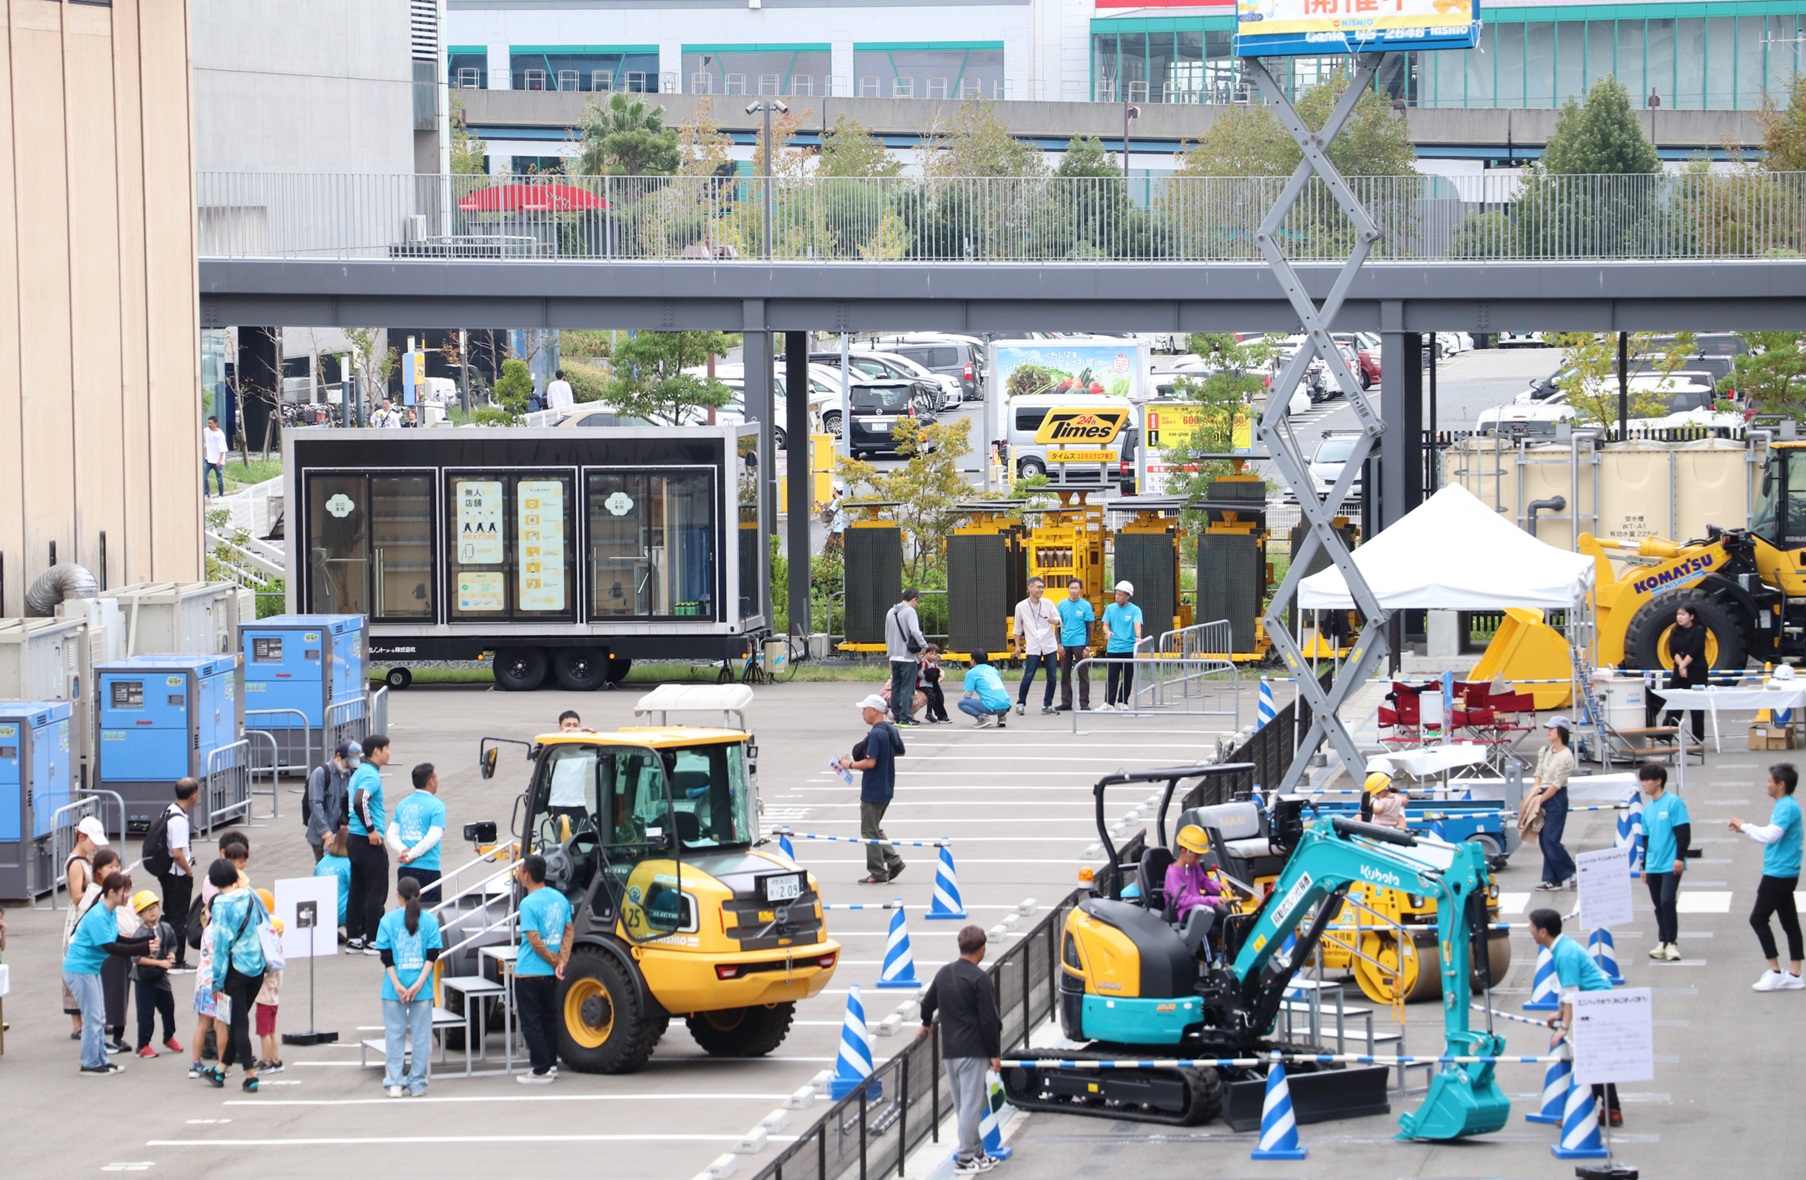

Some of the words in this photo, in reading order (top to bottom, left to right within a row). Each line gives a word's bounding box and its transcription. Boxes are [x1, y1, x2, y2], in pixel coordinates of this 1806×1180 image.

[1341, 18, 1374, 27] NISHIO
[1430, 25, 1469, 36] NISHIO
[1050, 421, 1112, 439] Times
[464, 488, 482, 497] 無人
[464, 499, 483, 508] 店舗
[1624, 515, 1645, 523] 受水槽
[461, 533, 498, 541] NEXTORE
[1609, 530, 1636, 538] 有効水量
[1633, 553, 1714, 595] KOMATSU
[1360, 864, 1401, 887] Kubota
[653, 910, 685, 919] ELECTRI
